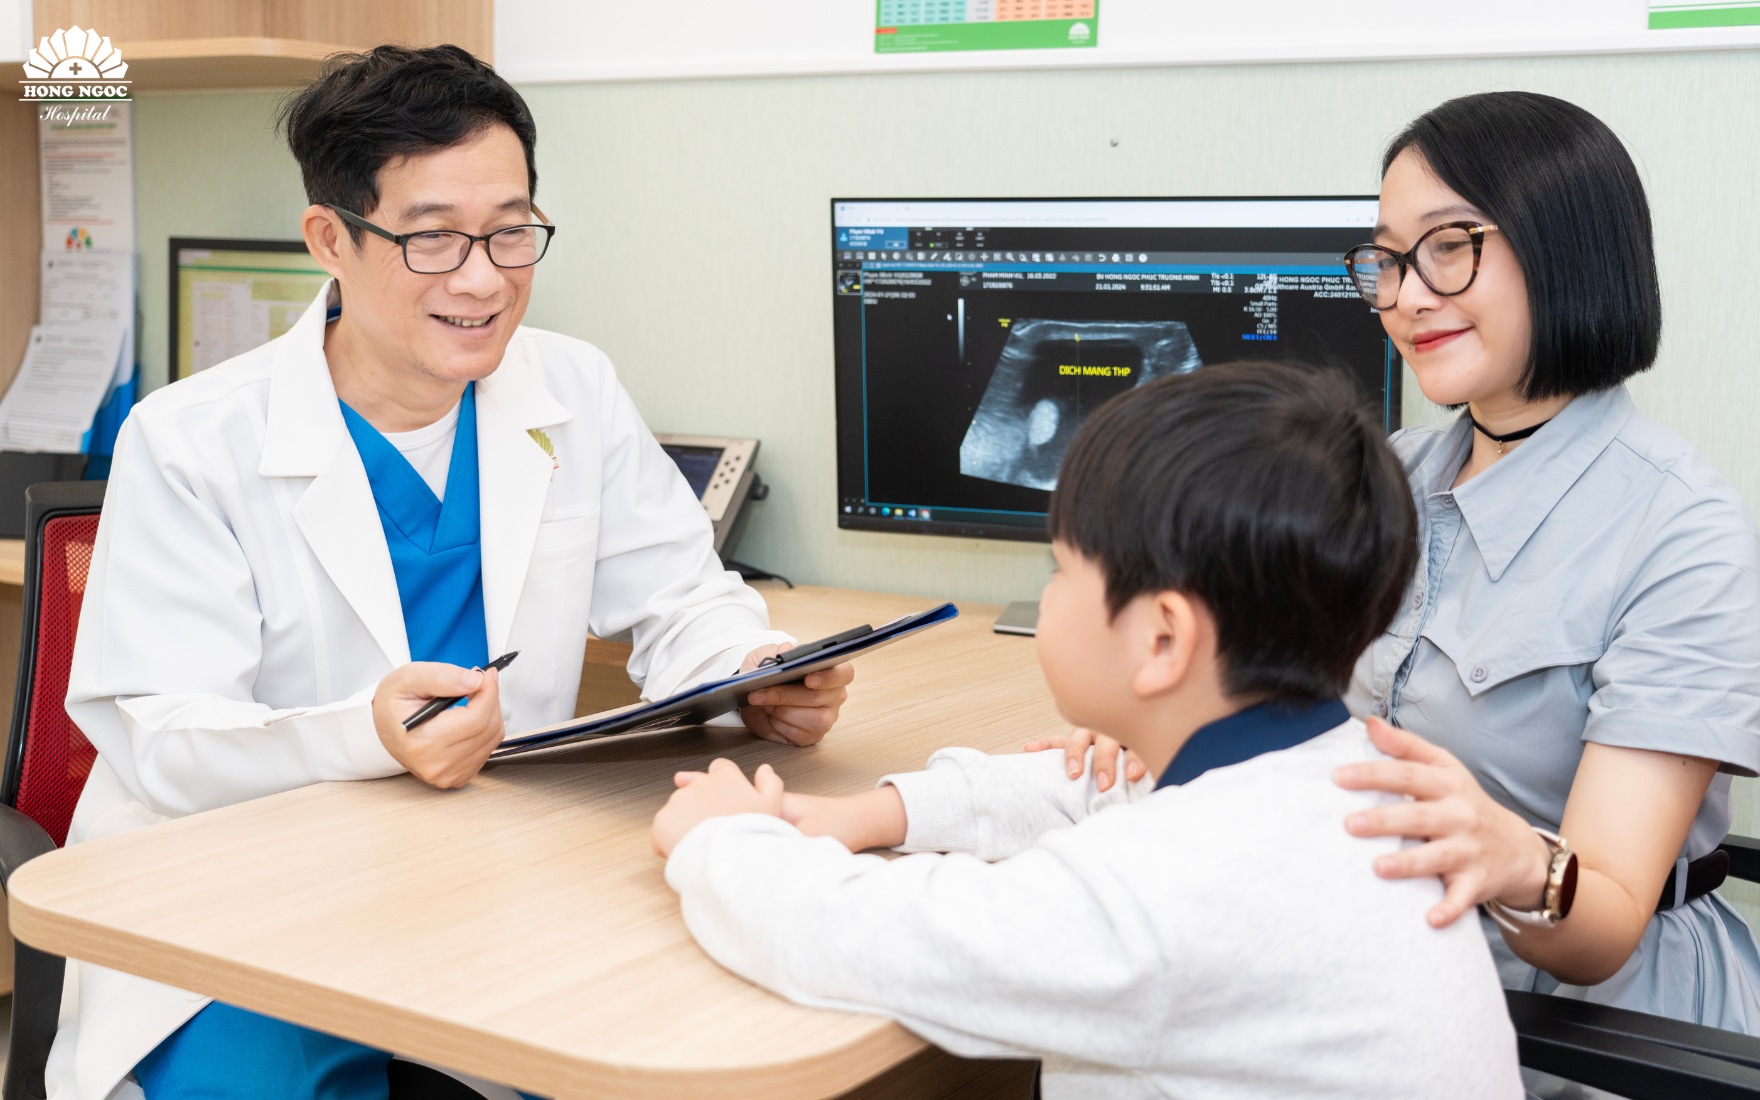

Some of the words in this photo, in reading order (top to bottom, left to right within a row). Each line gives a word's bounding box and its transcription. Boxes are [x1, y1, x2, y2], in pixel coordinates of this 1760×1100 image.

[1105, 273, 1123, 281] HONG
[1123, 273, 1141, 281] NGOC
[1140, 273, 1158, 281] PHUC
[1158, 273, 1183, 281] TRUONG
[1279, 276, 1299, 284] HONG
[1059, 365, 1081, 375] DICH
[1082, 366, 1111, 377] MANG
[1112, 366, 1131, 377] THP
